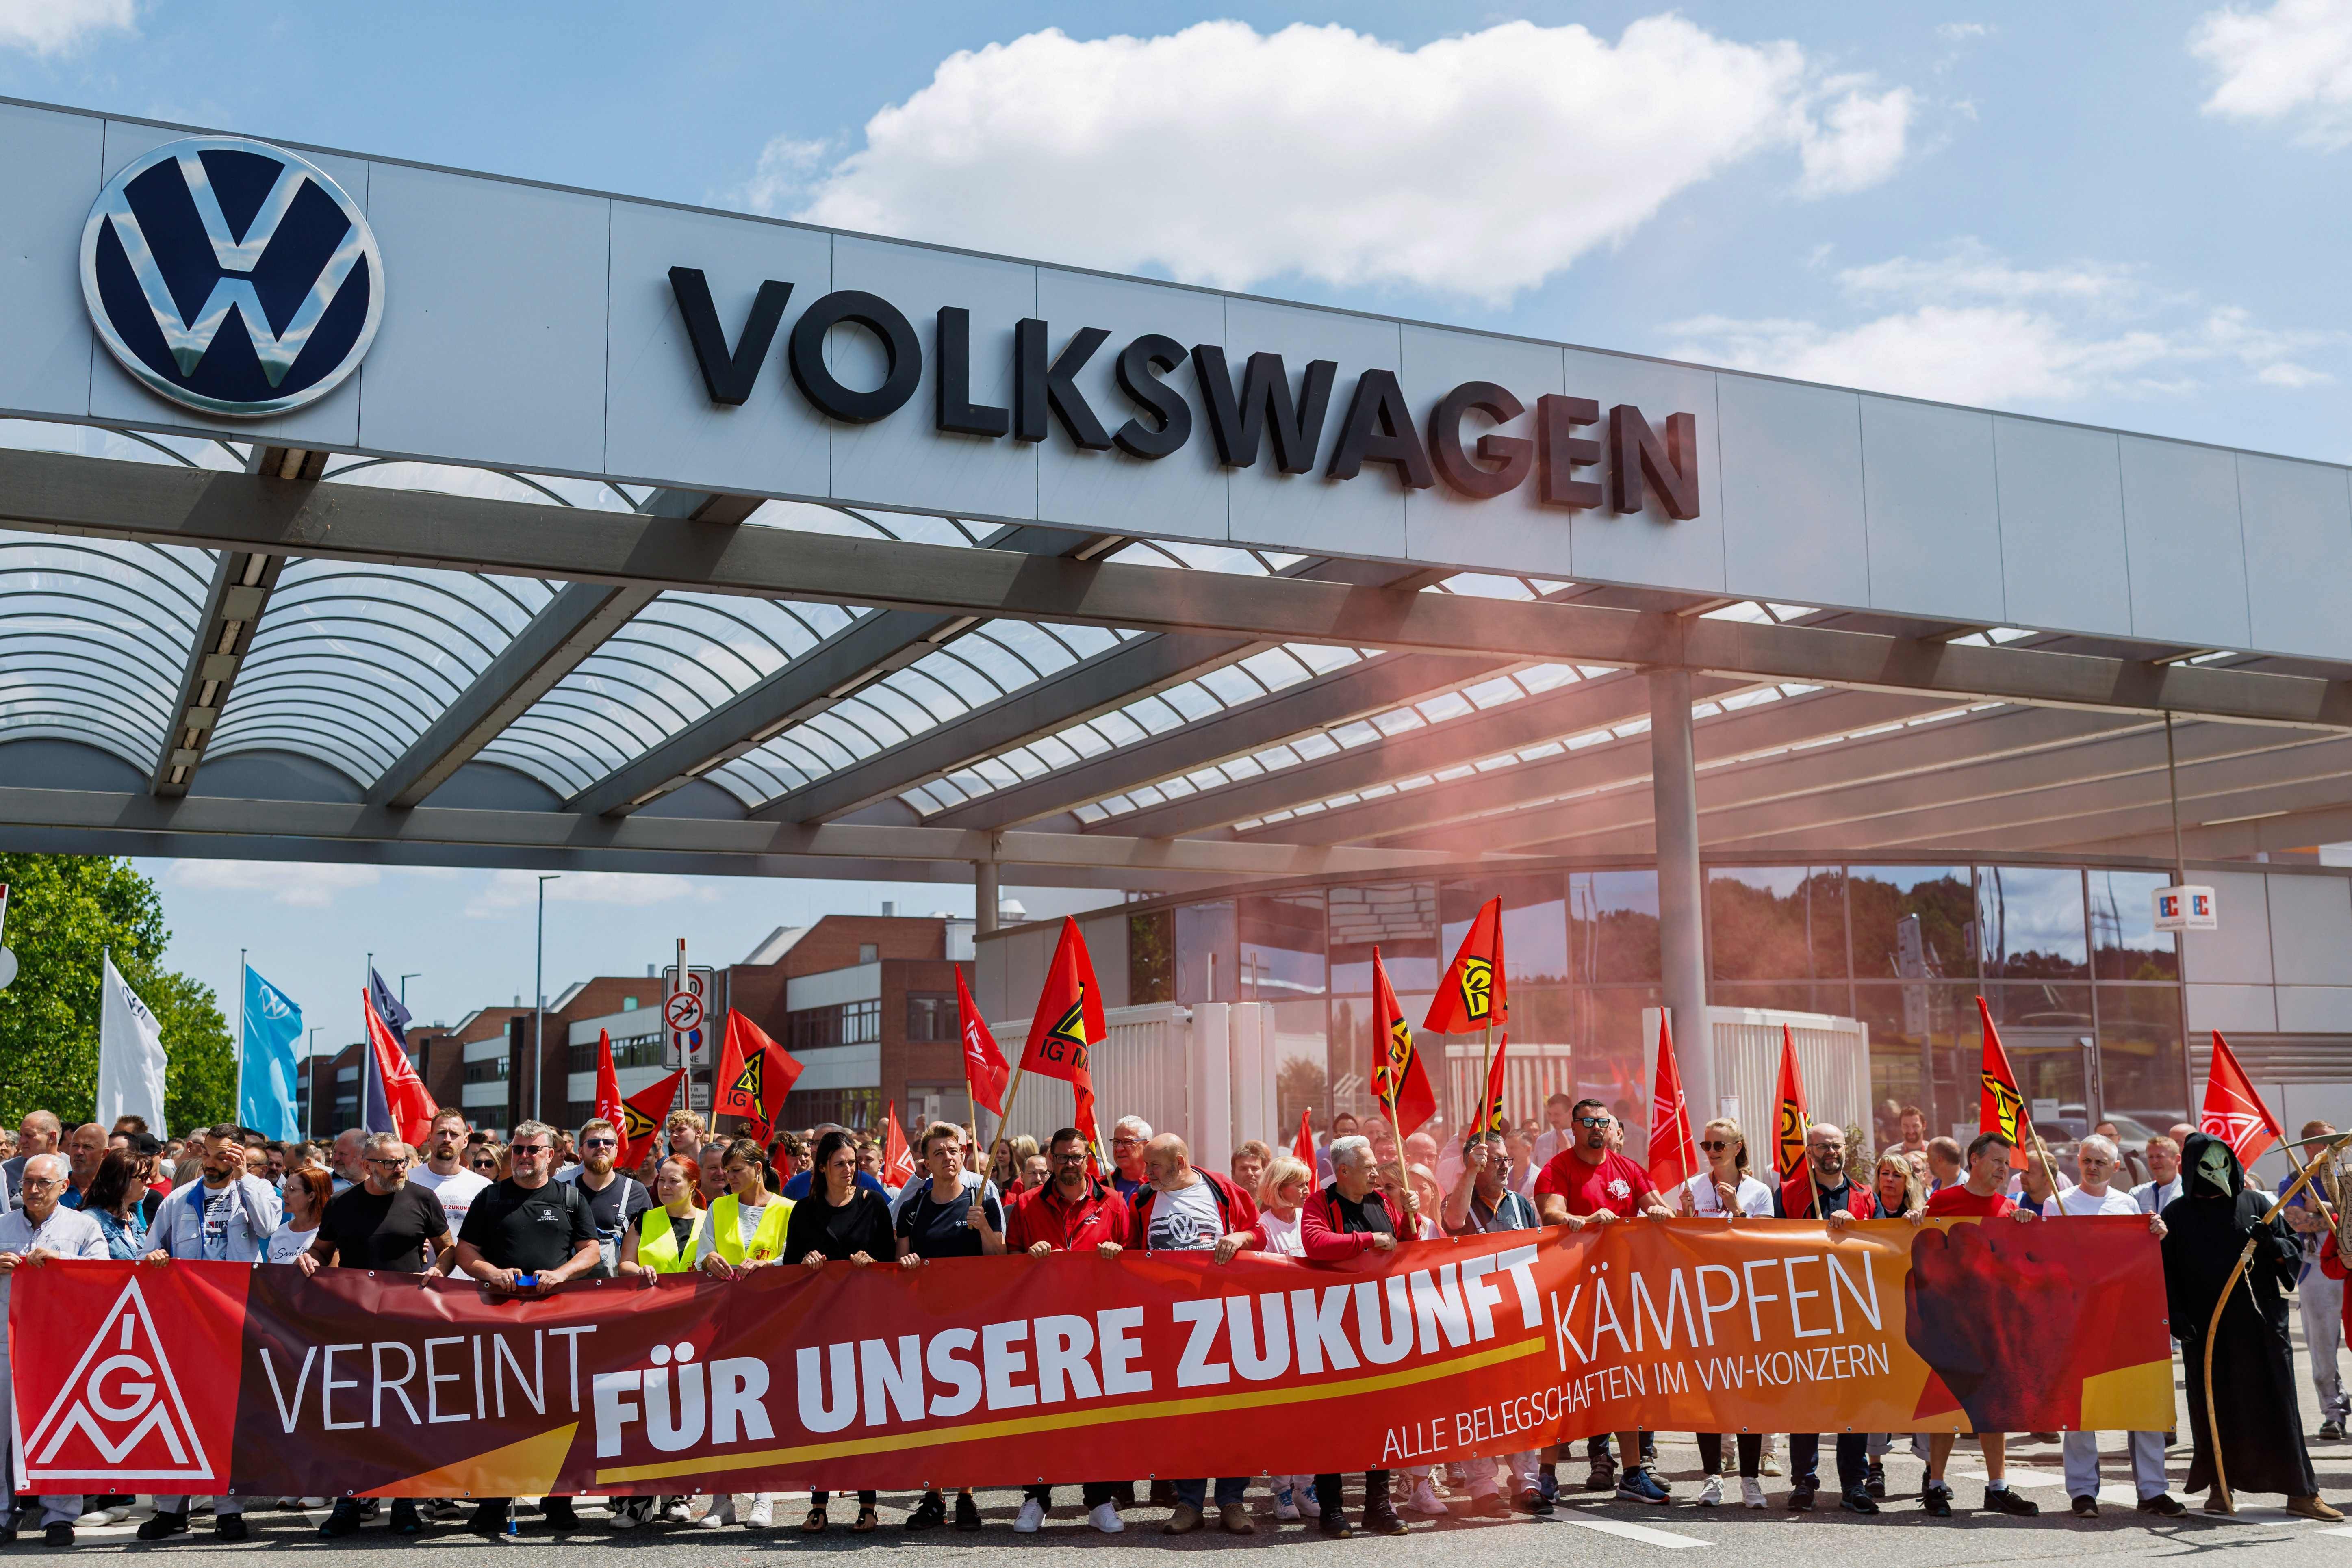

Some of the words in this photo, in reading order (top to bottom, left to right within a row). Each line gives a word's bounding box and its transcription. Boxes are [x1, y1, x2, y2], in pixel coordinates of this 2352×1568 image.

[83, 138, 383, 410] VW
[668, 266, 1700, 520] VOLKSWAGEN
[1039, 1038, 1065, 1063] IG
[727, 1091, 746, 1107] IG
[215, 1220, 228, 1229] DIES
[1170, 1213, 1199, 1244] VW
[260, 1325, 597, 1433] VEREINT
[593, 1342, 775, 1458] FÜR
[796, 1306, 1153, 1433] UNSERE
[1173, 1244, 1543, 1388] ZUKUNFT
[1551, 1251, 1882, 1372] KÄMPFEN
[1383, 1418, 1448, 1462] ALLE
[1456, 1364, 1645, 1446] BELEGSCHAFTEN
[1654, 1362, 1688, 1394] IM
[1695, 1343, 1889, 1391] VW-KONZERN
